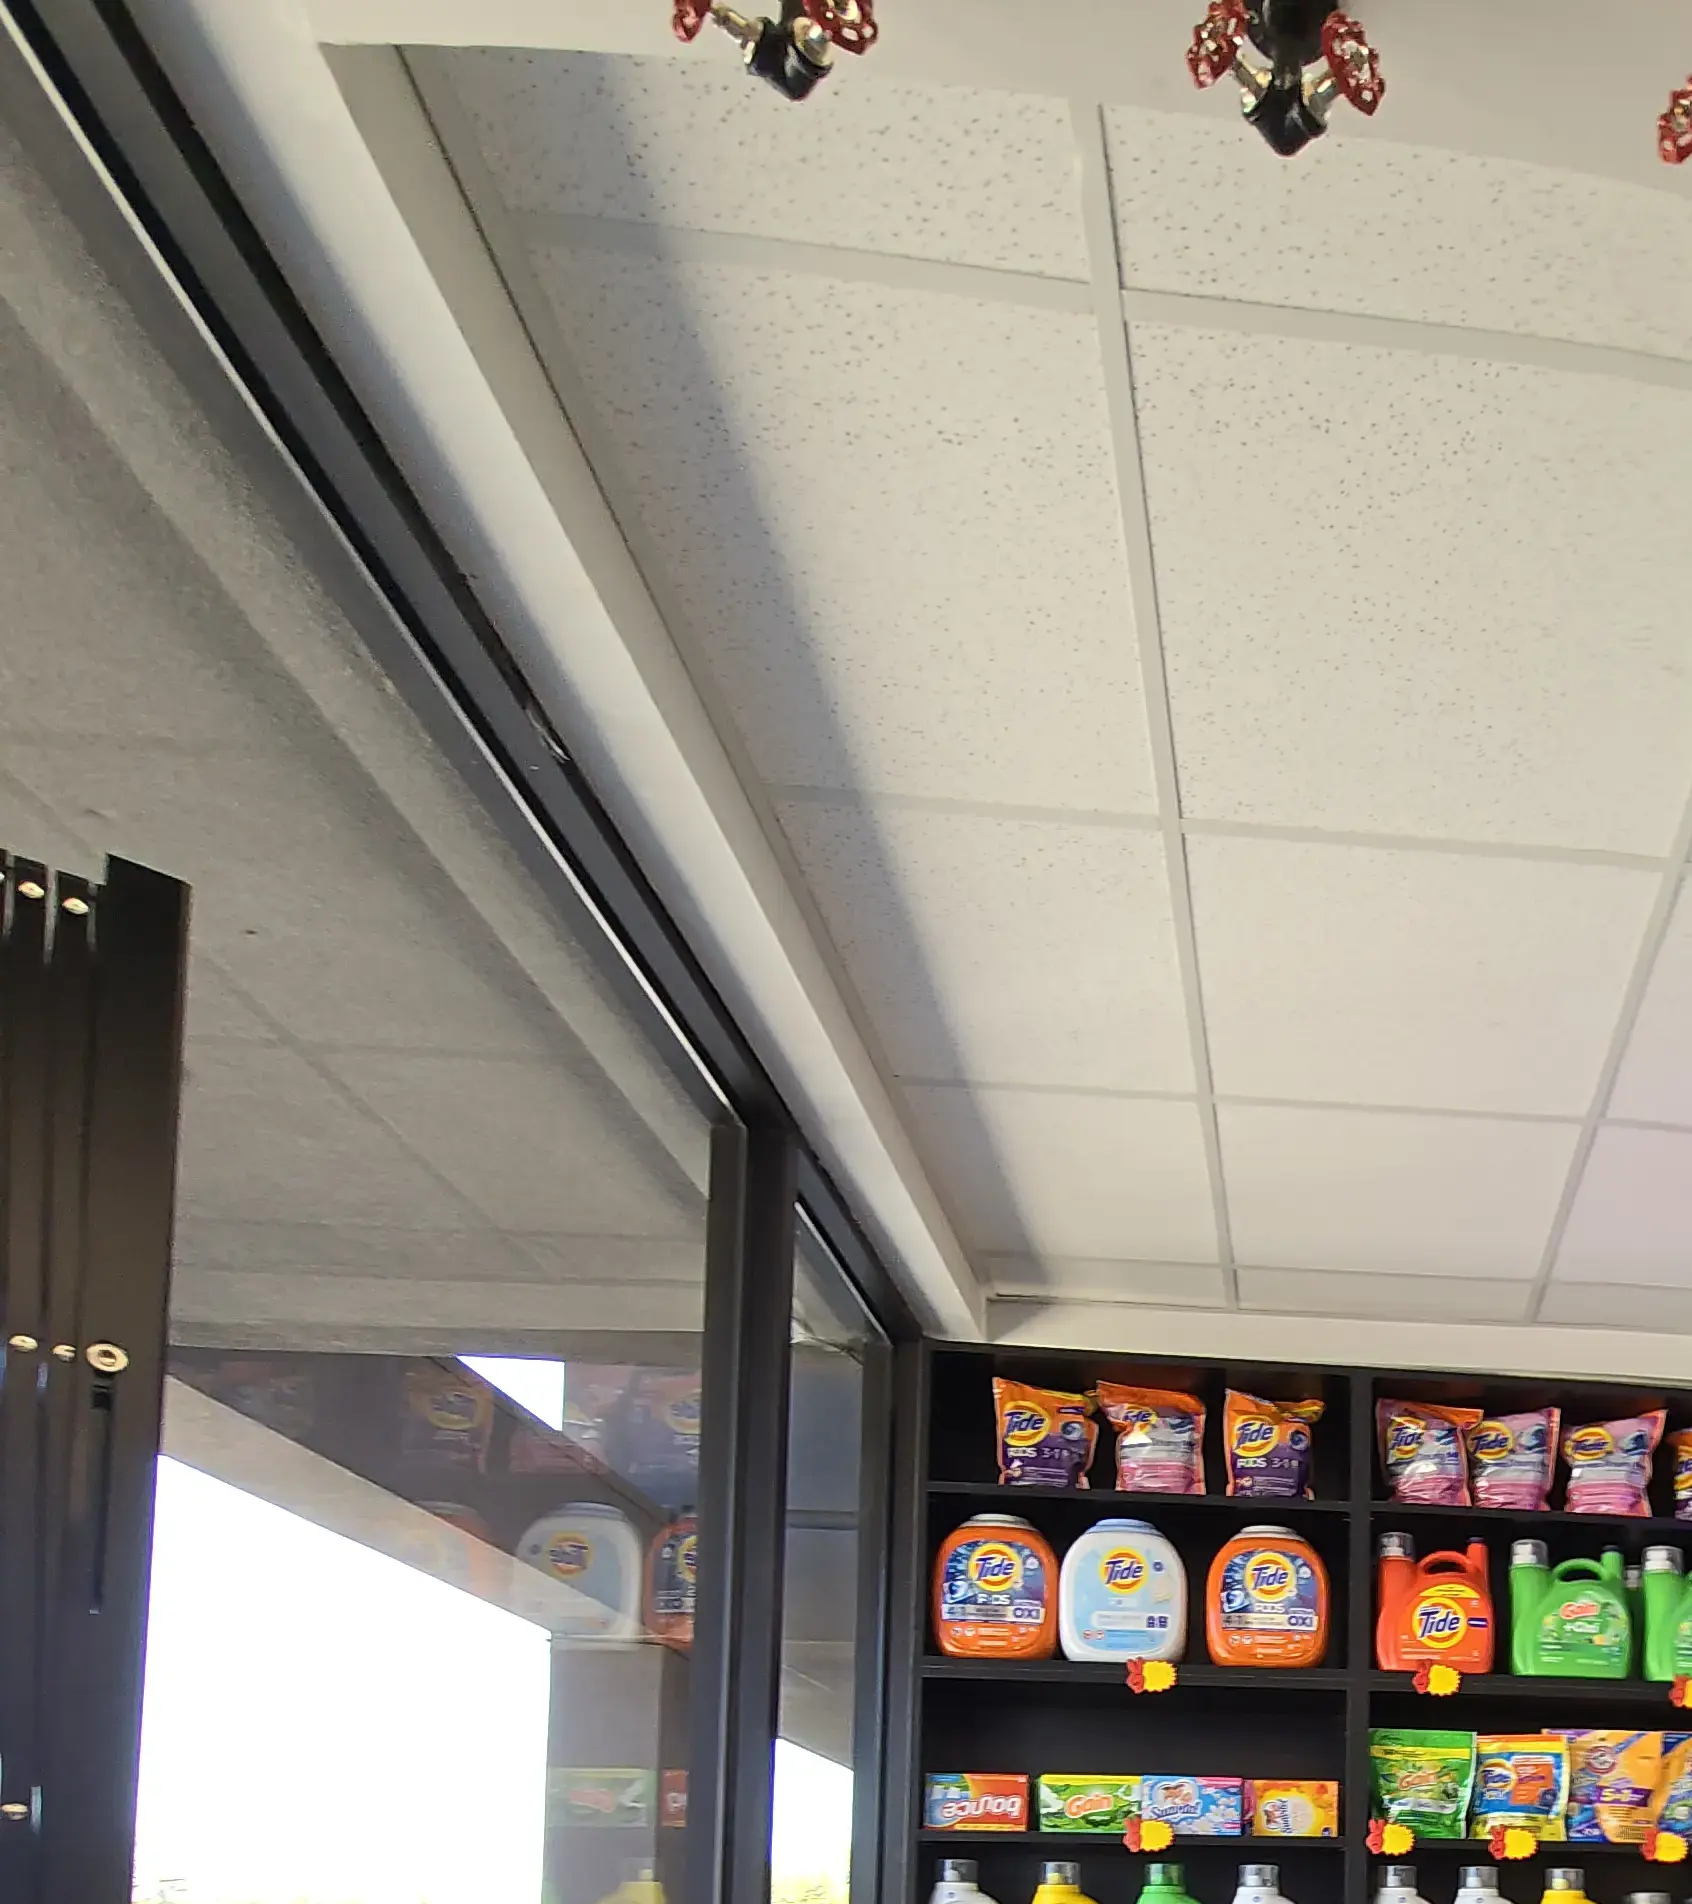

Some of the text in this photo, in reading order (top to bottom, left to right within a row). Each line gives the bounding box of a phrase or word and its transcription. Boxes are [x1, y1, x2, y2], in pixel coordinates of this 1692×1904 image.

[1003, 1406, 1046, 1436] Tide
[1235, 1422, 1275, 1450] Tide
[973, 1555, 1017, 1588] Tide
[1104, 1558, 1145, 1589] Tide
[1250, 1567, 1290, 1599] Tide
[1416, 1608, 1462, 1640] Tide
[1064, 1793, 1115, 1819] Gain
